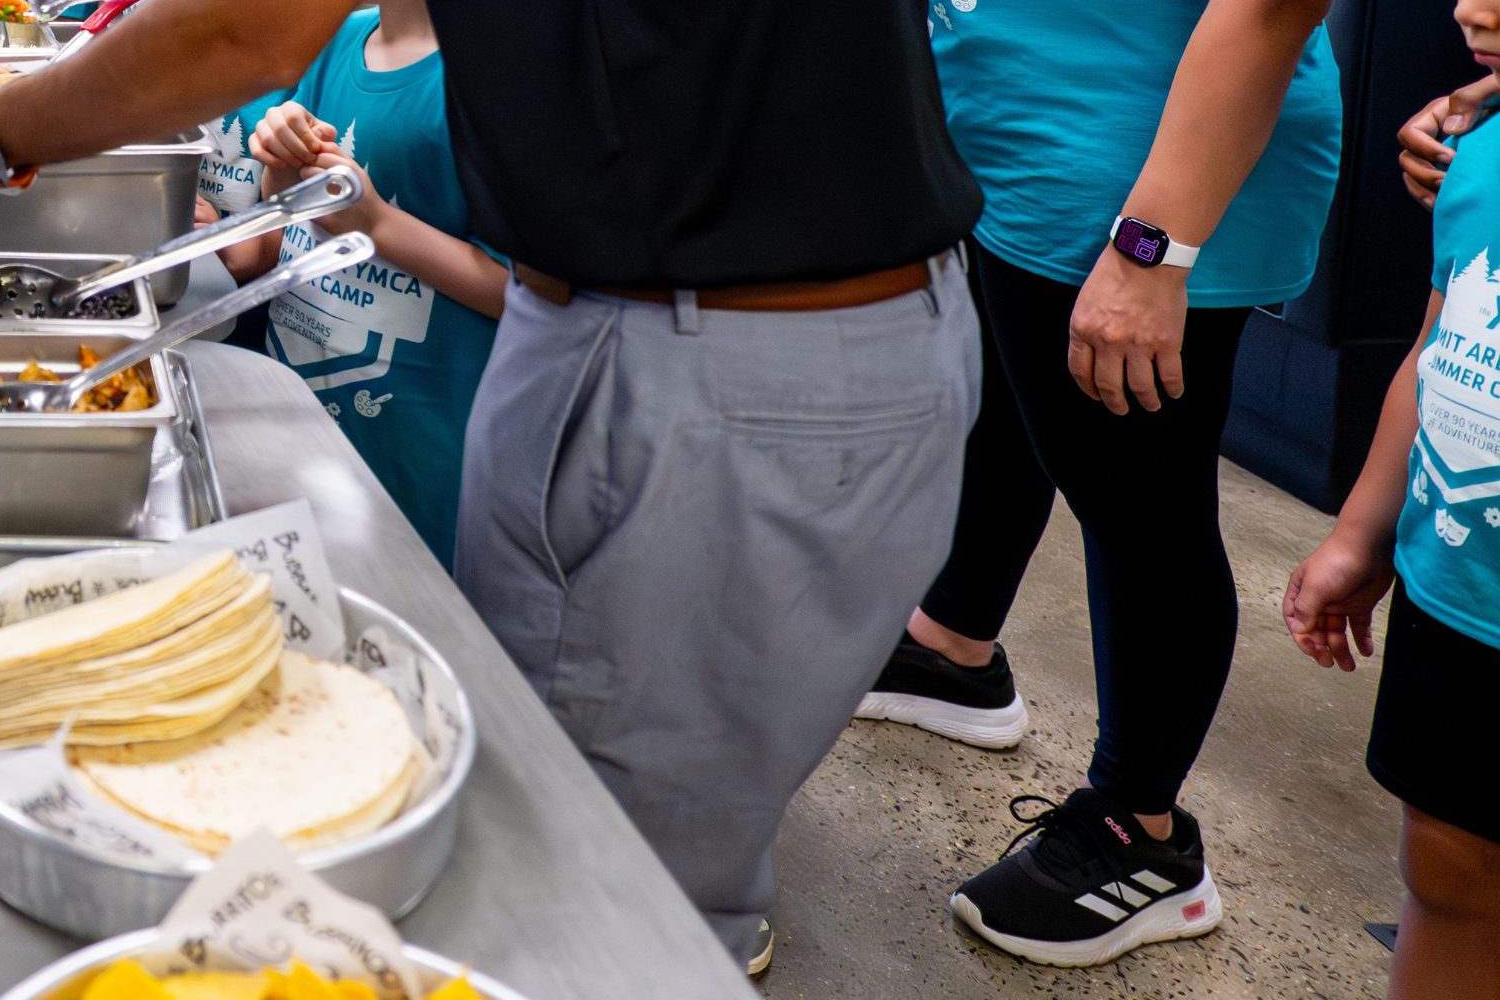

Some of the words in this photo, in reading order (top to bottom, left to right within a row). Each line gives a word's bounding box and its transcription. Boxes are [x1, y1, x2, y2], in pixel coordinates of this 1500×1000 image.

[212, 161, 255, 185] YMCA
[199, 178, 224, 196] AMP
[1134, 237, 1160, 263] 10
[320, 275, 375, 308] CAMP
[355, 262, 422, 299] YMCA
[282, 316, 328, 350] ADVENTURE
[304, 315, 332, 338] YEARS
[1439, 327, 1466, 353] MIT
[1428, 354, 1485, 392] UMMER
[1429, 402, 1450, 419] OVER
[1452, 414, 1466, 428] 90
[1438, 421, 1500, 456] ADVENTURE
[1104, 816, 1132, 845] adida
